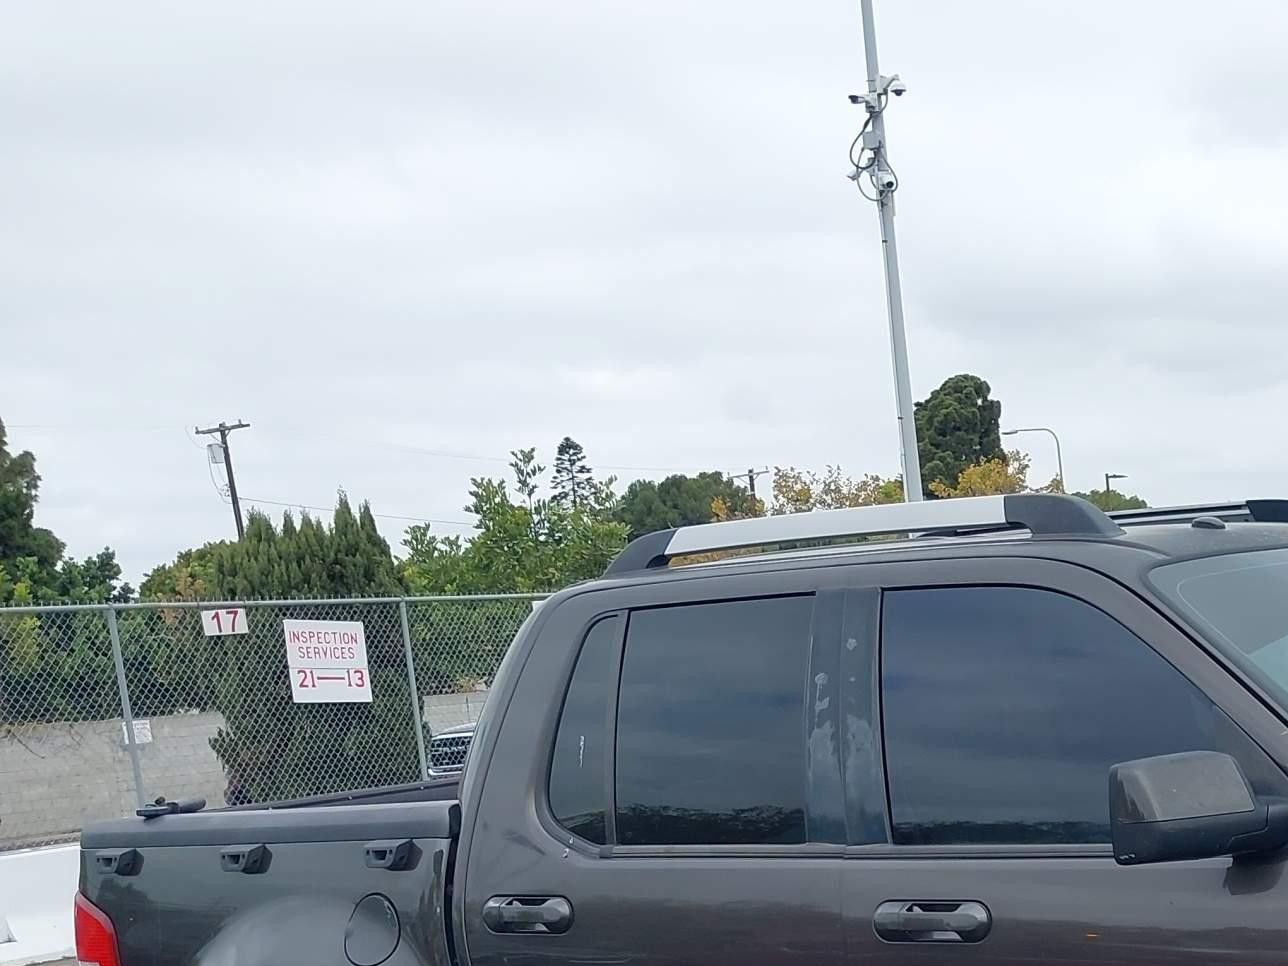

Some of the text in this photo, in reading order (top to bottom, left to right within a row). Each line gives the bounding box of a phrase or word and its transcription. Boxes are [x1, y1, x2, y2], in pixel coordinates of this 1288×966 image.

[211, 610, 239, 633] 17
[289, 630, 358, 645] INSPECTION
[298, 647, 355, 660] SERVICES
